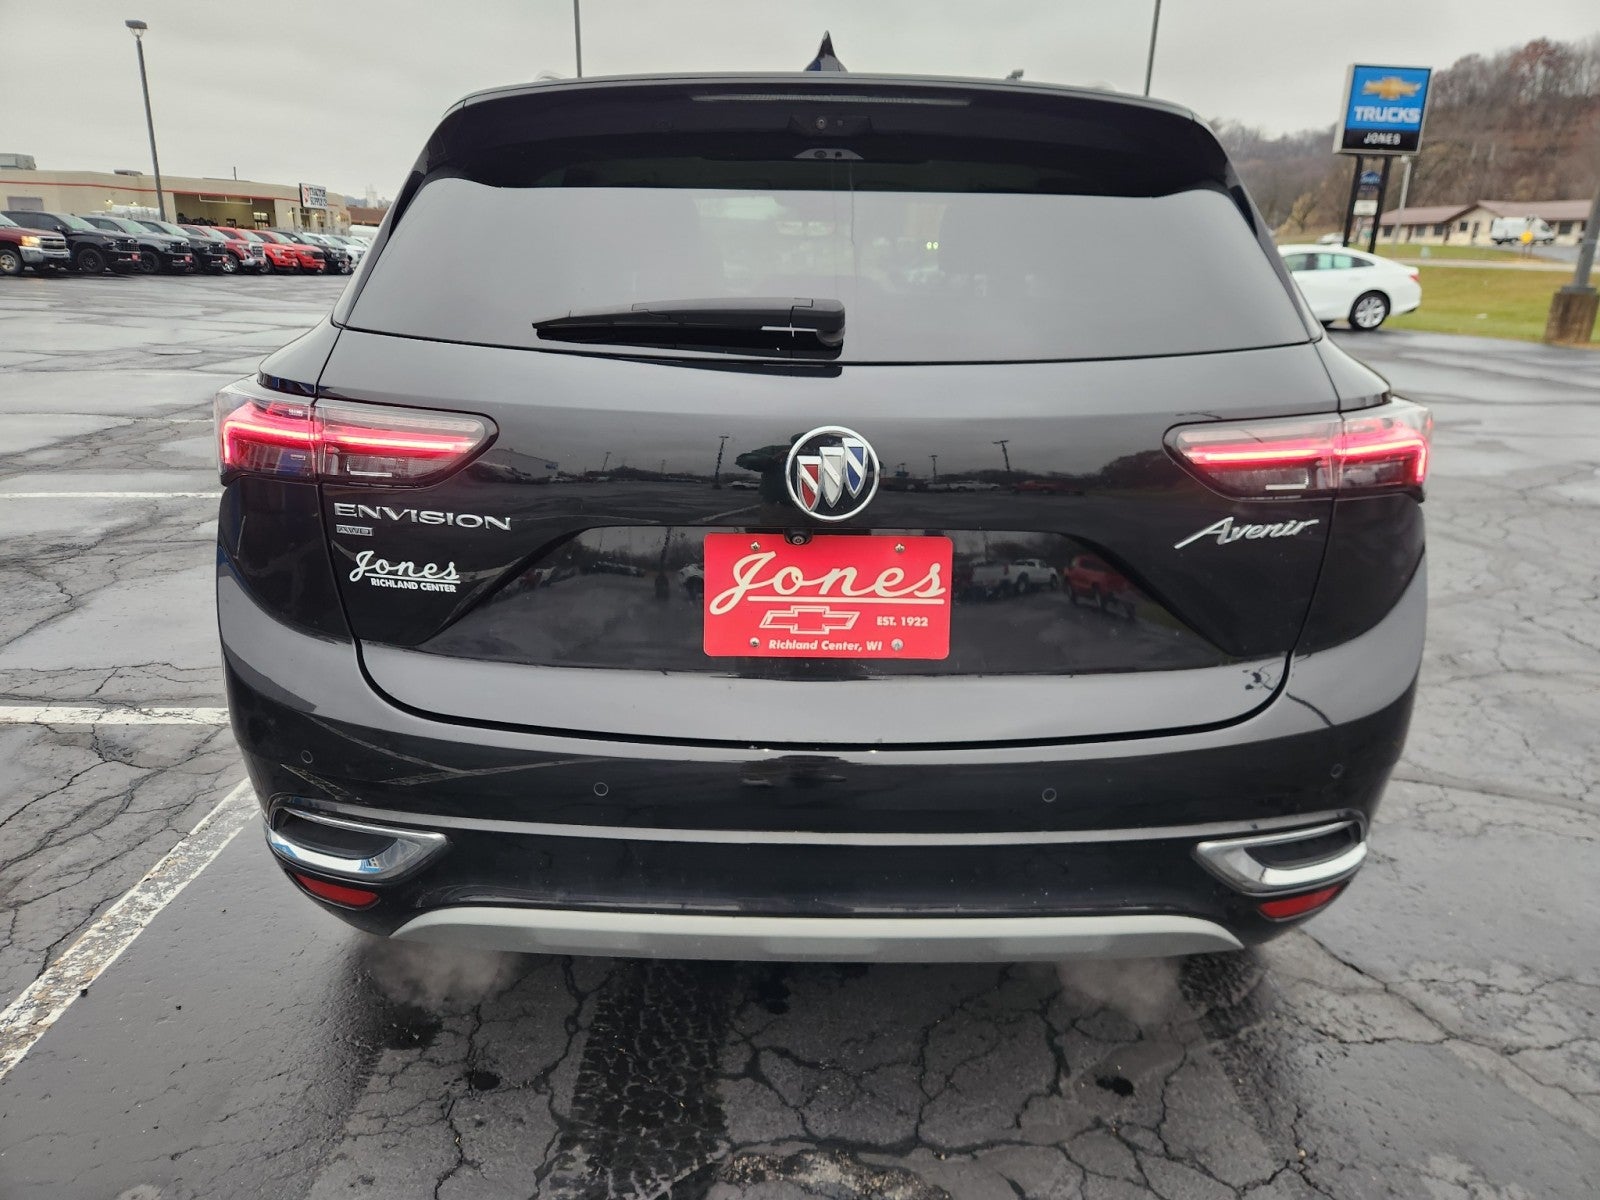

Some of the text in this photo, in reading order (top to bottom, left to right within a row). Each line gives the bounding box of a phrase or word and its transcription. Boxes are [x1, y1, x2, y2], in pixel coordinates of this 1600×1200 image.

[1354, 105, 1421, 124] TRUCKS
[1363, 132, 1401, 146] JONES
[334, 502, 512, 531] ENVISION
[336, 525, 372, 536] AWD
[1174, 516, 1320, 549] Avenir
[349, 550, 460, 582] Jones
[371, 577, 457, 593] RICHLAND CENTER
[709, 551, 946, 615] Jones
[876, 616, 929, 628] EST. 1922
[768, 639, 883, 652] Richland Center, WI
